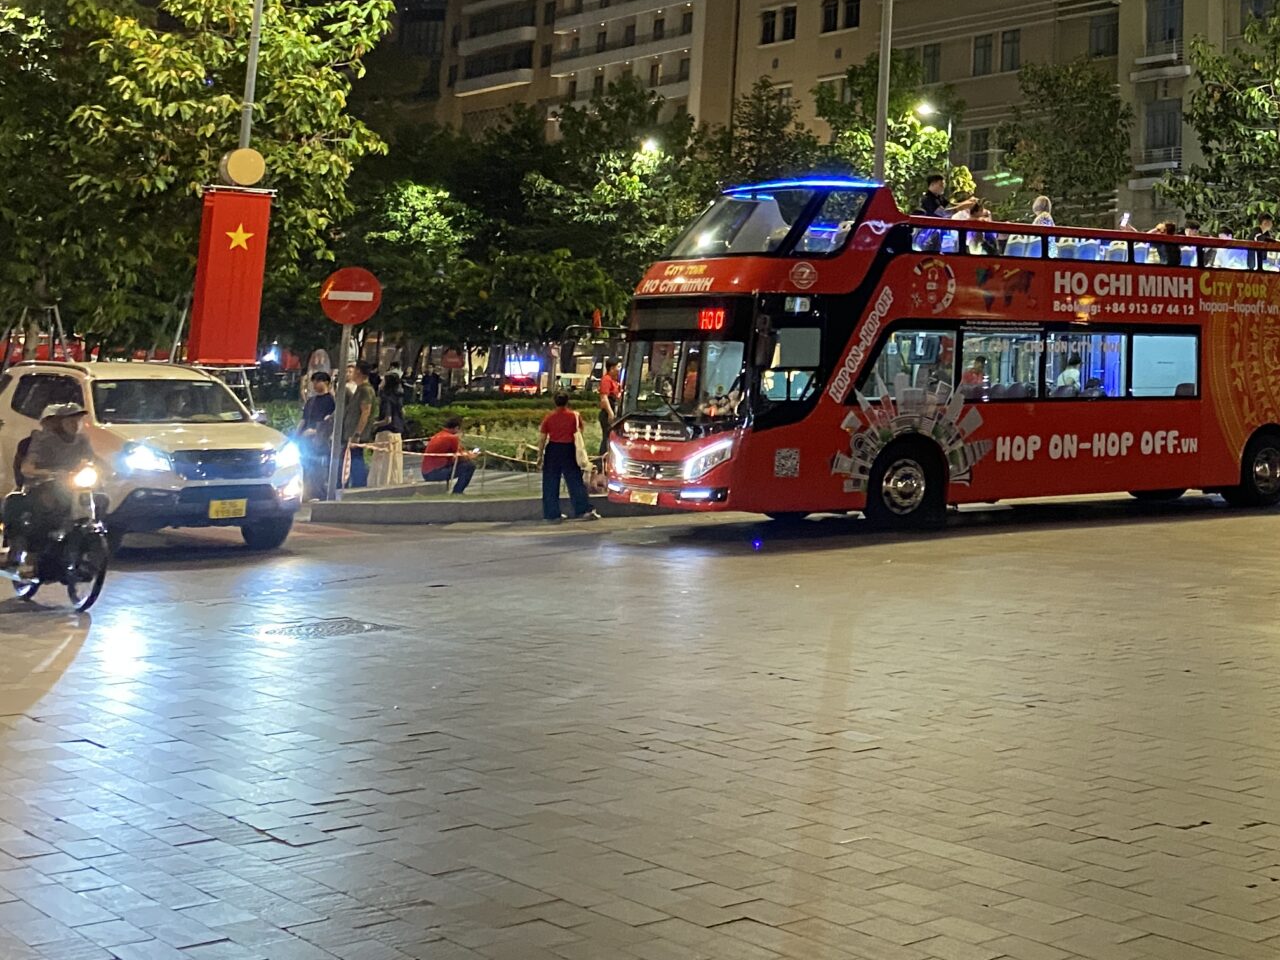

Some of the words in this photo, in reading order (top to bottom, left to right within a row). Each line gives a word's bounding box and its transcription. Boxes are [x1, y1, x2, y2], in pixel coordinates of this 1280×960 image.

[664, 264, 683, 276] CITY
[642, 278, 658, 293] HO
[659, 278, 681, 292] CHI
[682, 277, 714, 291] MINH
[1054, 271, 1088, 295] HO
[1094, 273, 1132, 296] CHI
[1138, 275, 1194, 298] MINH
[1236, 282, 1267, 298] TOUR
[1105, 302, 1126, 314] +84
[1129, 303, 1148, 315] 913
[1151, 304, 1164, 315] 67
[1166, 304, 1180, 315] 44
[1183, 304, 1195, 316] 12
[1200, 298, 1280, 316] hopon-hopoff.vn
[829, 368, 851, 403] HOP
[996, 435, 1042, 462] HOP
[1140, 430, 1198, 455] OFF.VN
